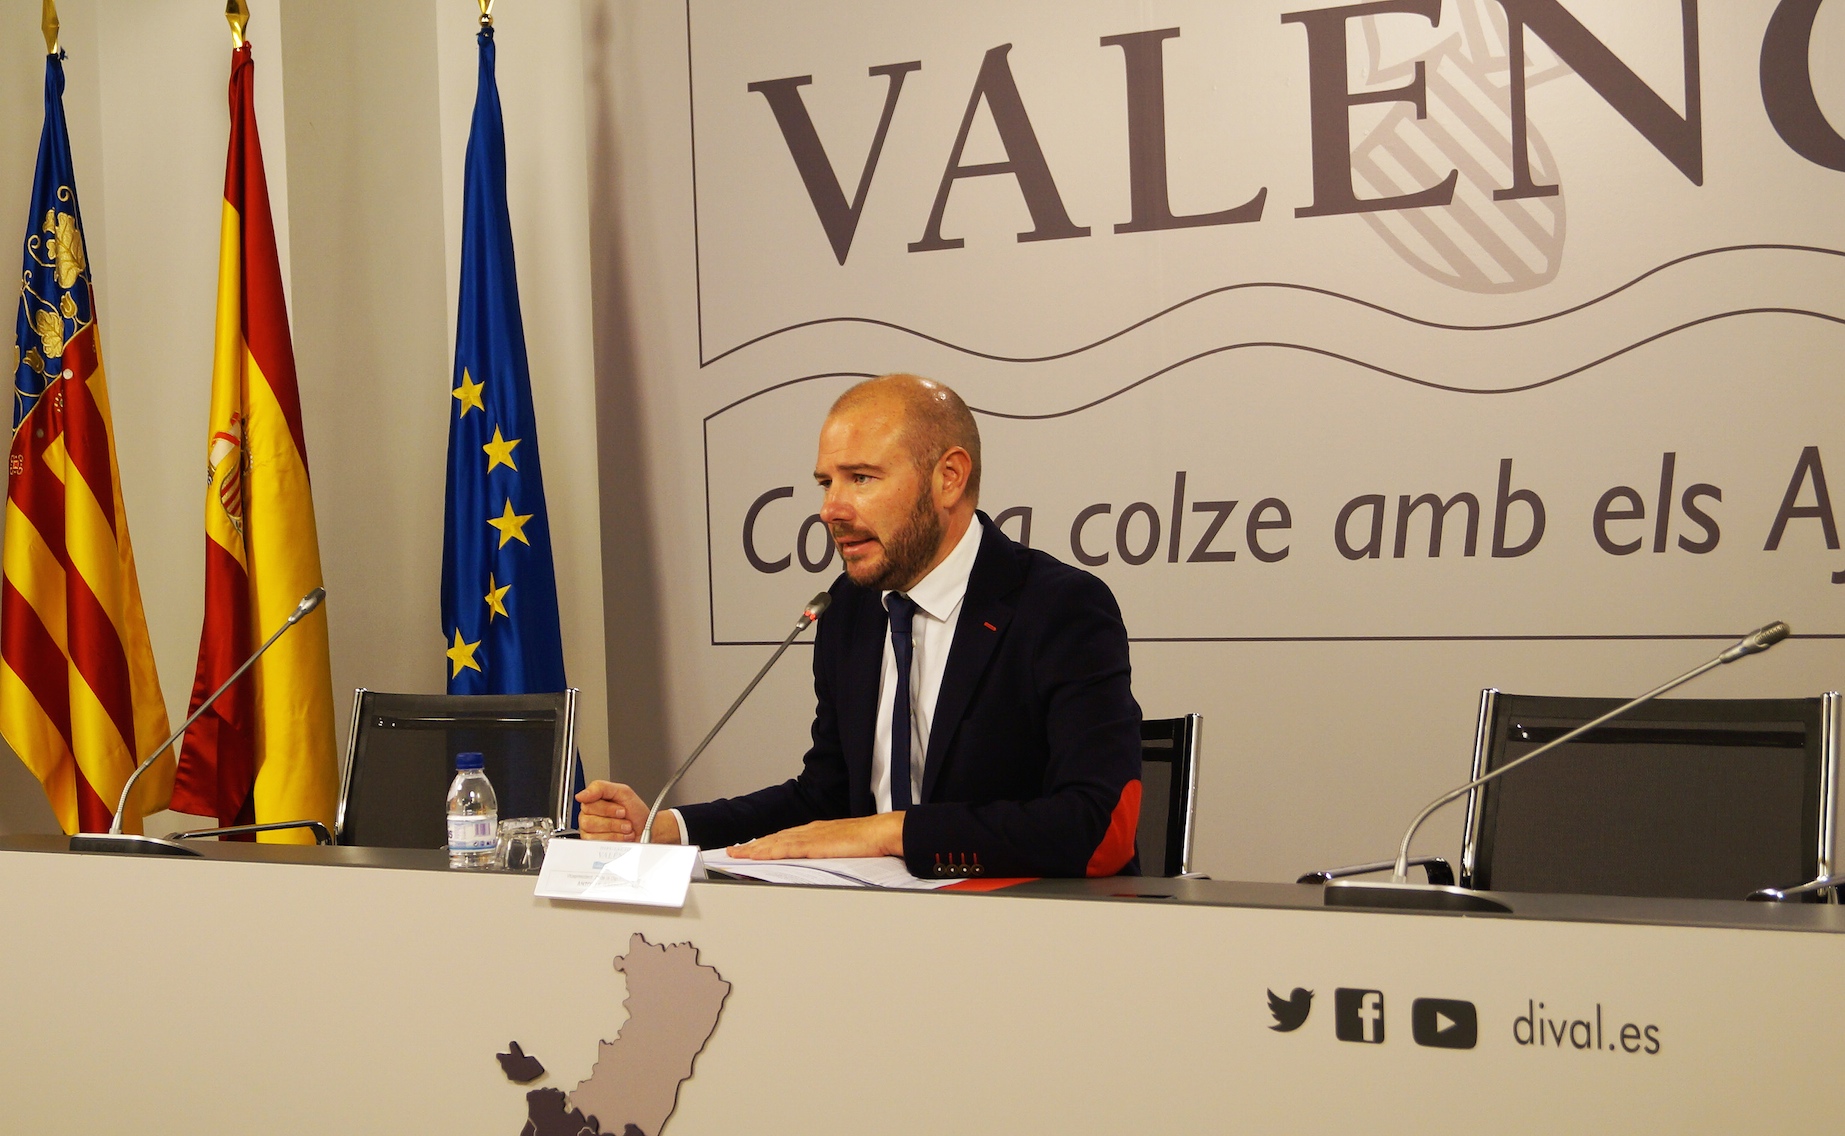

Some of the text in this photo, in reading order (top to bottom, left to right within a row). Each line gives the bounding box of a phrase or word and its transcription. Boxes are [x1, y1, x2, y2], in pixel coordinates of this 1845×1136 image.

[743, 486, 846, 574] Co
[1070, 471, 1292, 566] colze
[1334, 458, 1546, 560] amb
[1592, 451, 1722, 556] els
[1763, 446, 1845, 585] A
[1513, 999, 1661, 1055] dival.es
